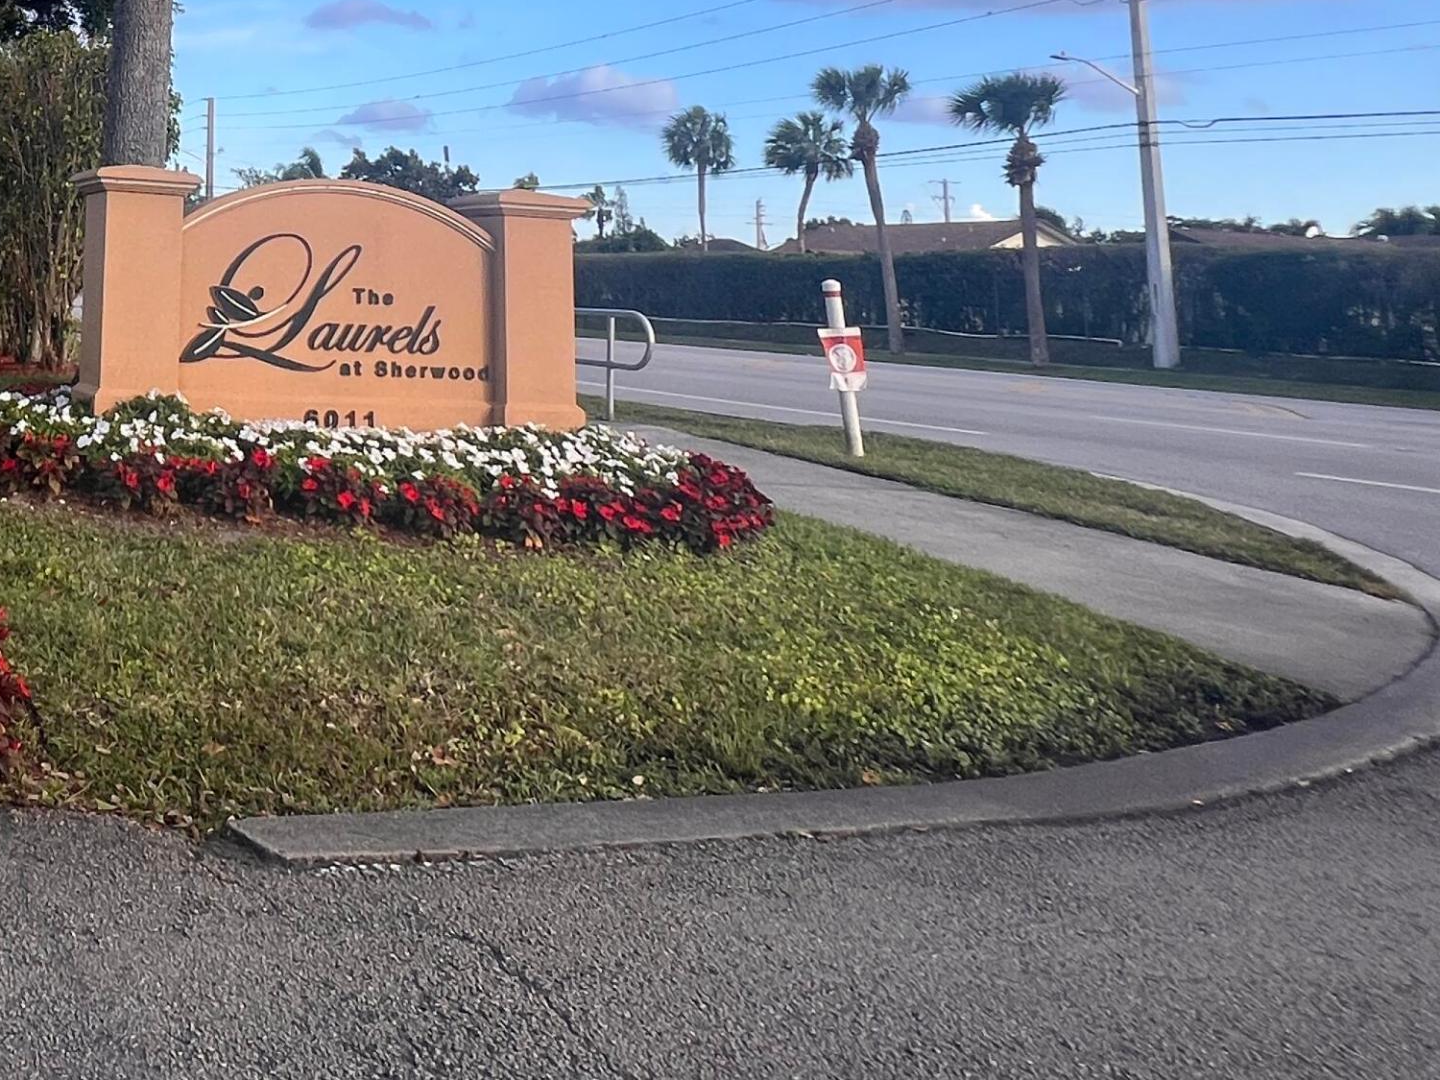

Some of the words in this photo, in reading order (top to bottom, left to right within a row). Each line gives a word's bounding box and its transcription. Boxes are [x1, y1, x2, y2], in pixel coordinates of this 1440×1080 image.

[200, 232, 442, 373] Laurels
[352, 287, 394, 306] The
[339, 361, 362, 377] at
[374, 360, 490, 382] Sherwood
[303, 409, 375, 430] 6011
